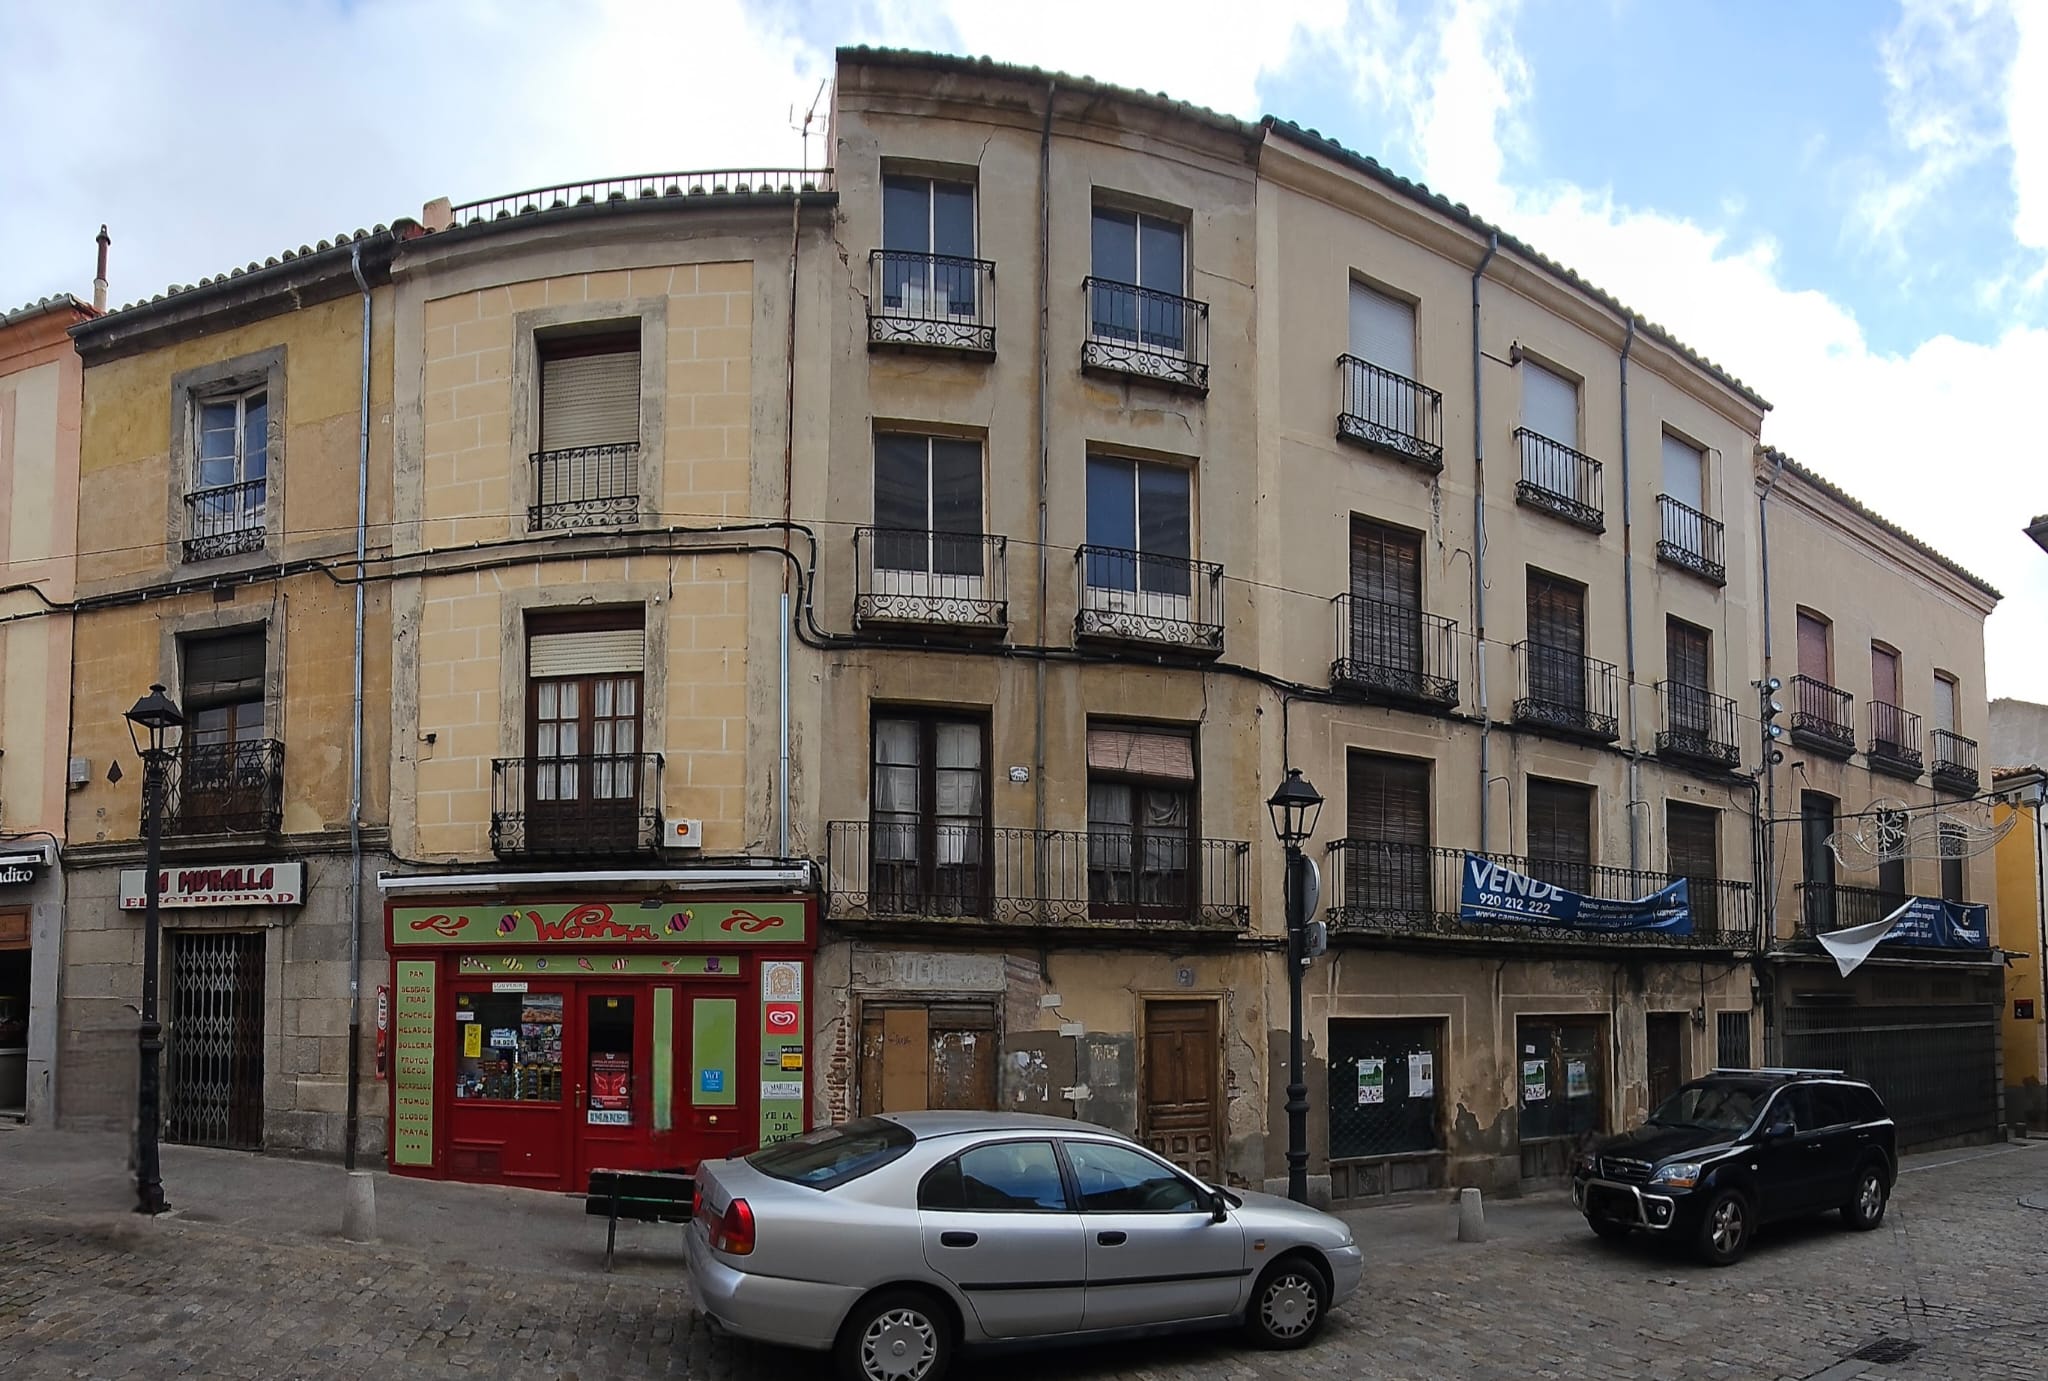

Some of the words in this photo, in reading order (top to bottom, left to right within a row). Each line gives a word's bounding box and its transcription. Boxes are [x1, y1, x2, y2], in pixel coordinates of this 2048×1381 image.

[0, 866, 33, 883] dito
[145, 871, 169, 893] A
[178, 867, 274, 895] MURALLA
[125, 892, 295, 907] ELCTRICIDAD
[1480, 892, 1501, 907] 920
[1505, 897, 1524, 911] 212
[1528, 900, 1551, 914] 222
[526, 903, 659, 943] Wonka
[401, 1056, 429, 1064] FRUTOS
[774, 1123, 789, 1131] DE
